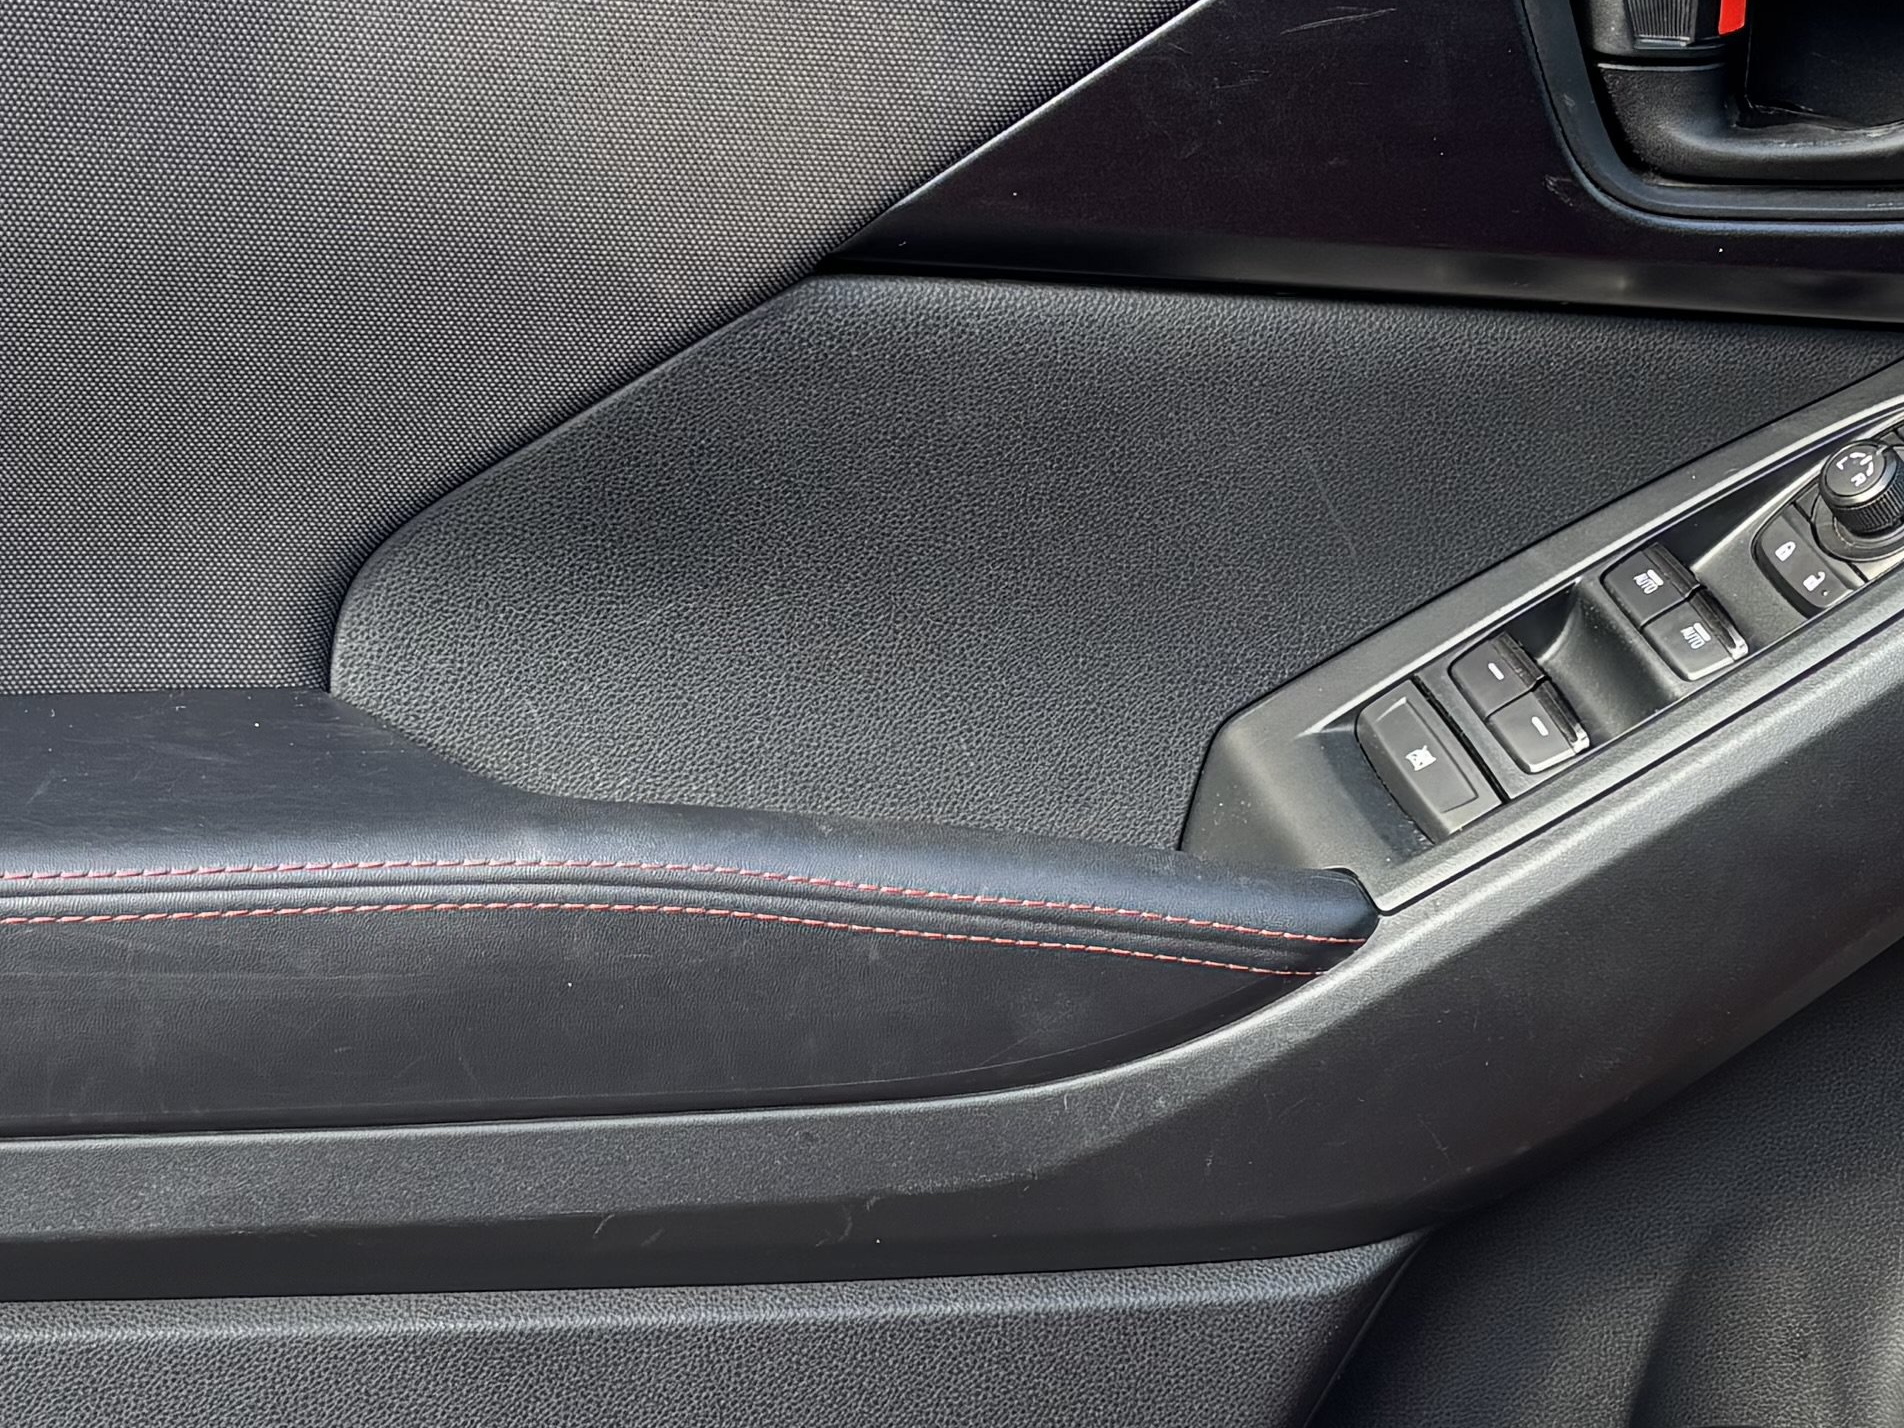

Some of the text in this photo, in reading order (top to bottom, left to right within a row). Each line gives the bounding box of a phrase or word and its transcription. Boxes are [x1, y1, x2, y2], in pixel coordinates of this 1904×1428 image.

[1835, 456, 1849, 471] L
[1850, 472, 1867, 487] R
[1633, 573, 1658, 594] AUTO
[1680, 626, 1706, 649] AUTO
